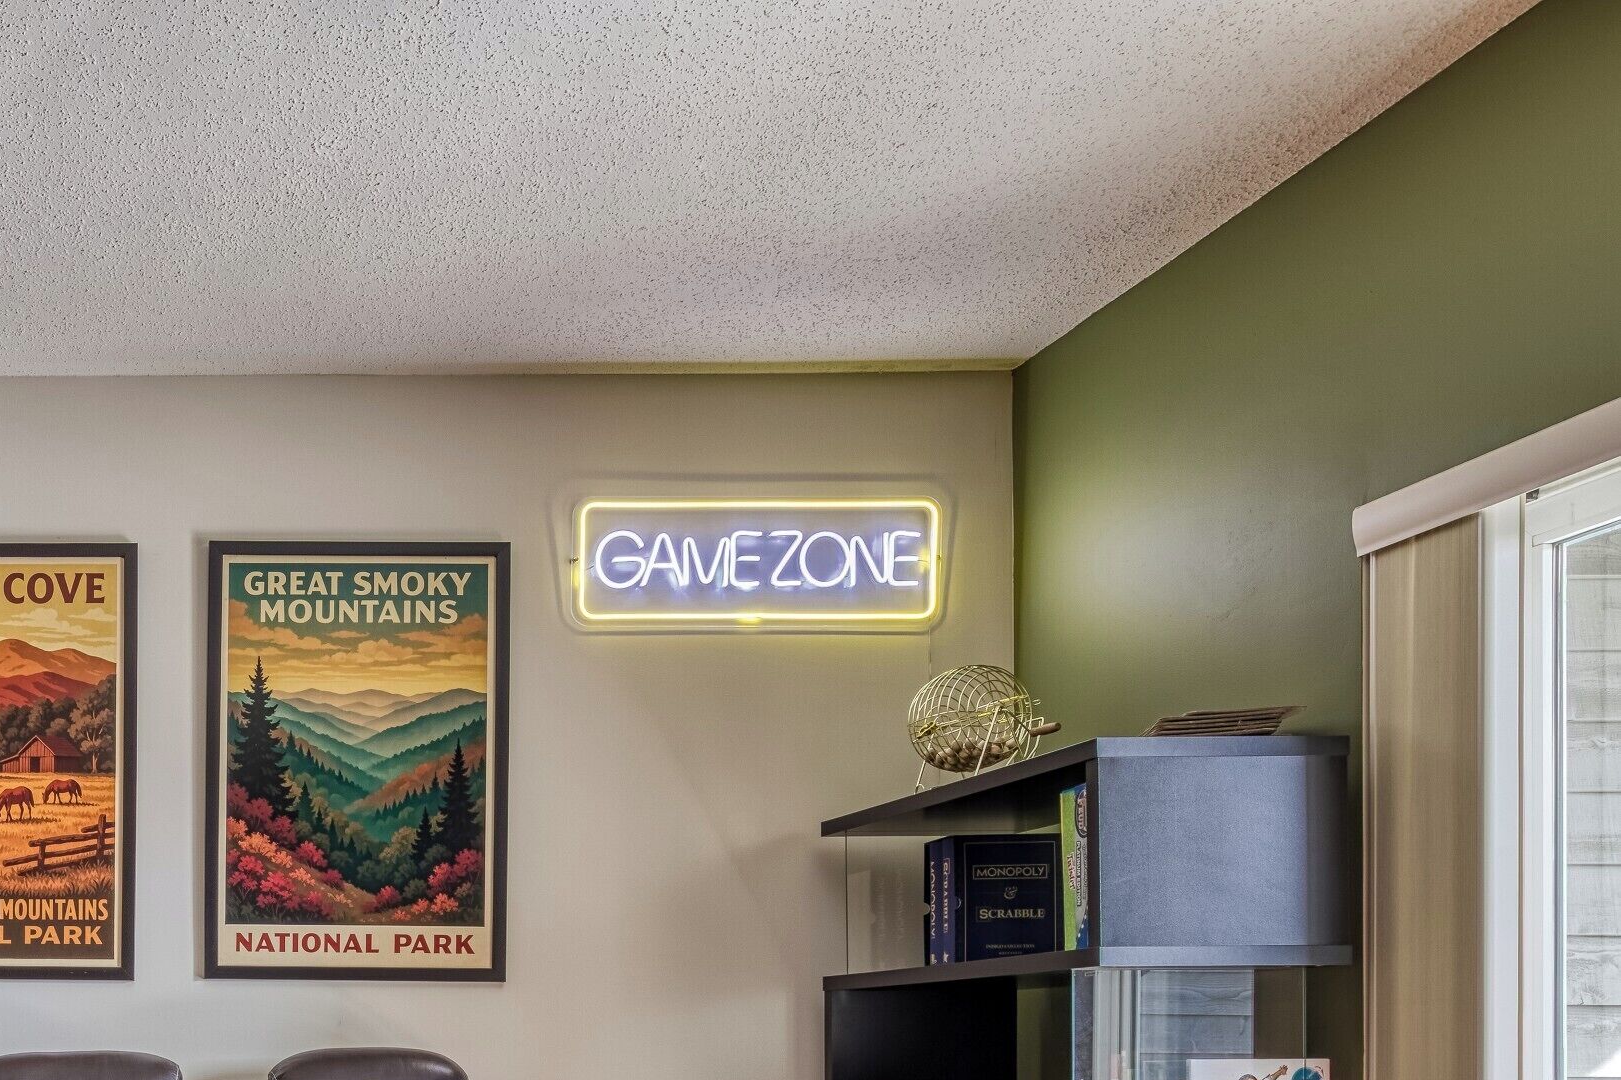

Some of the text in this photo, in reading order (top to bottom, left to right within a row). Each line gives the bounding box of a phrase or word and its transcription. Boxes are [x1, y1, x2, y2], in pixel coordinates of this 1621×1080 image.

[3, 572, 106, 604] COVE
[243, 571, 472, 596] GREAT SMOKY
[260, 599, 459, 624] MOUNTAINS
[976, 866, 1045, 877] MONOPOLY
[1003, 885, 1018, 900] &
[0, 898, 109, 921] MOUNTAINS
[979, 908, 1045, 919] SCRABBLE
[24, 925, 103, 945] PARK
[235, 932, 476, 955] NATIONAL PARK
